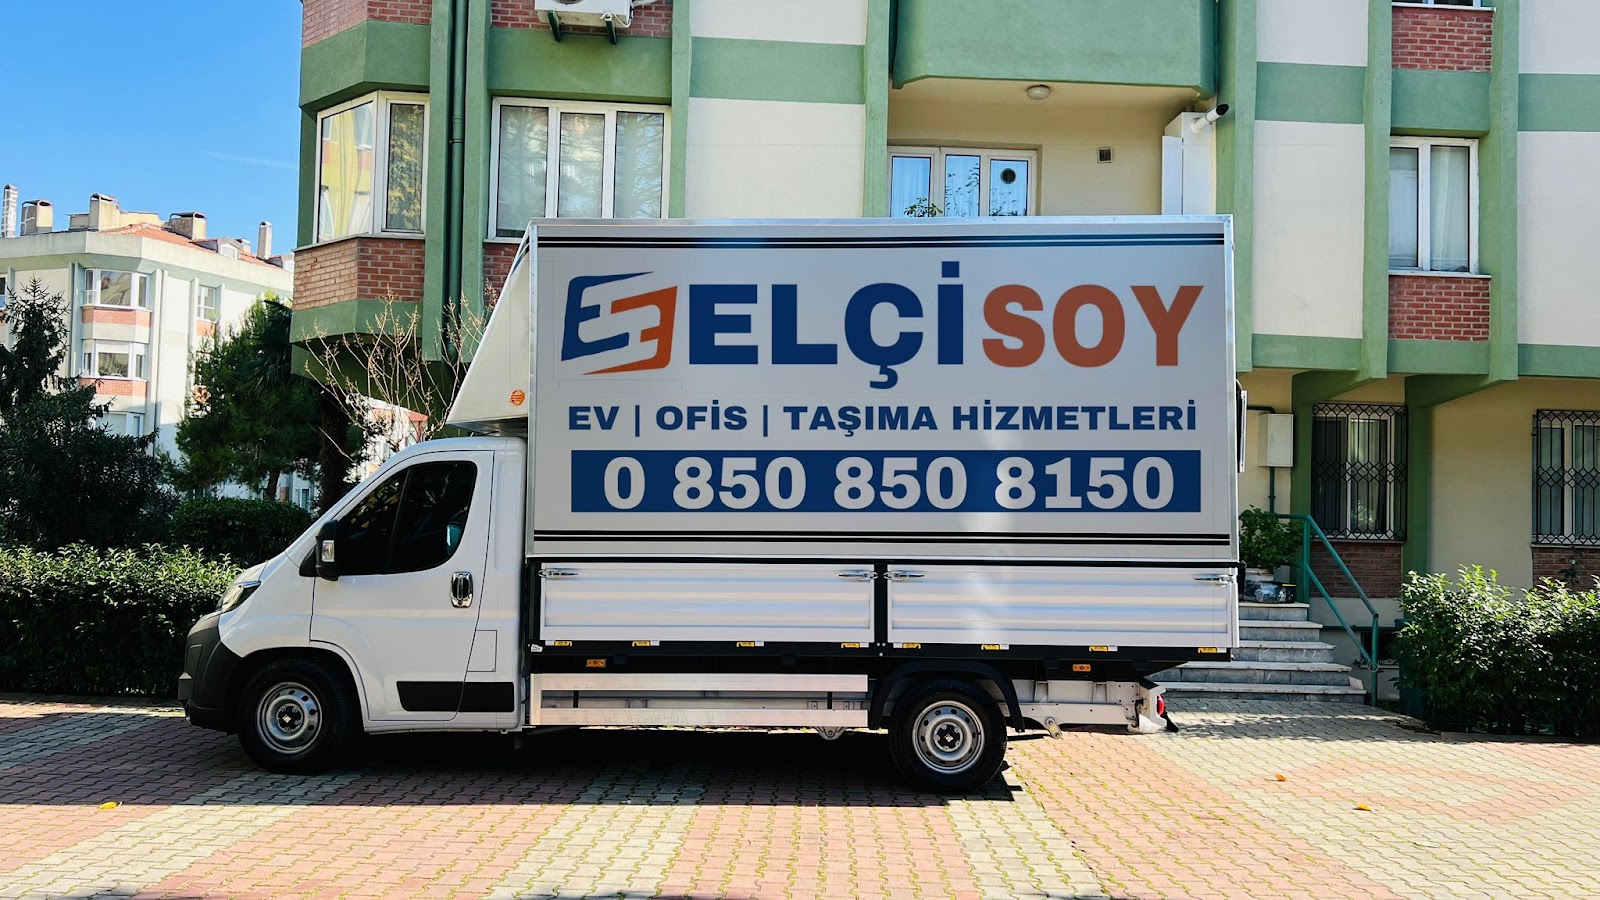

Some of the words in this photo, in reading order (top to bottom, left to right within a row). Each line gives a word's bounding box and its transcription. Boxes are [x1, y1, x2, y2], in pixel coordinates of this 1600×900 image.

[568, 405, 620, 431] EV
[655, 400, 748, 431] OFİS
[783, 405, 938, 437] TAŞIMA
[952, 400, 1197, 431] HİZMETLERİ
[604, 456, 646, 510] 0
[673, 456, 806, 510] 850
[833, 456, 967, 510] 850
[994, 456, 1174, 510] 8150
